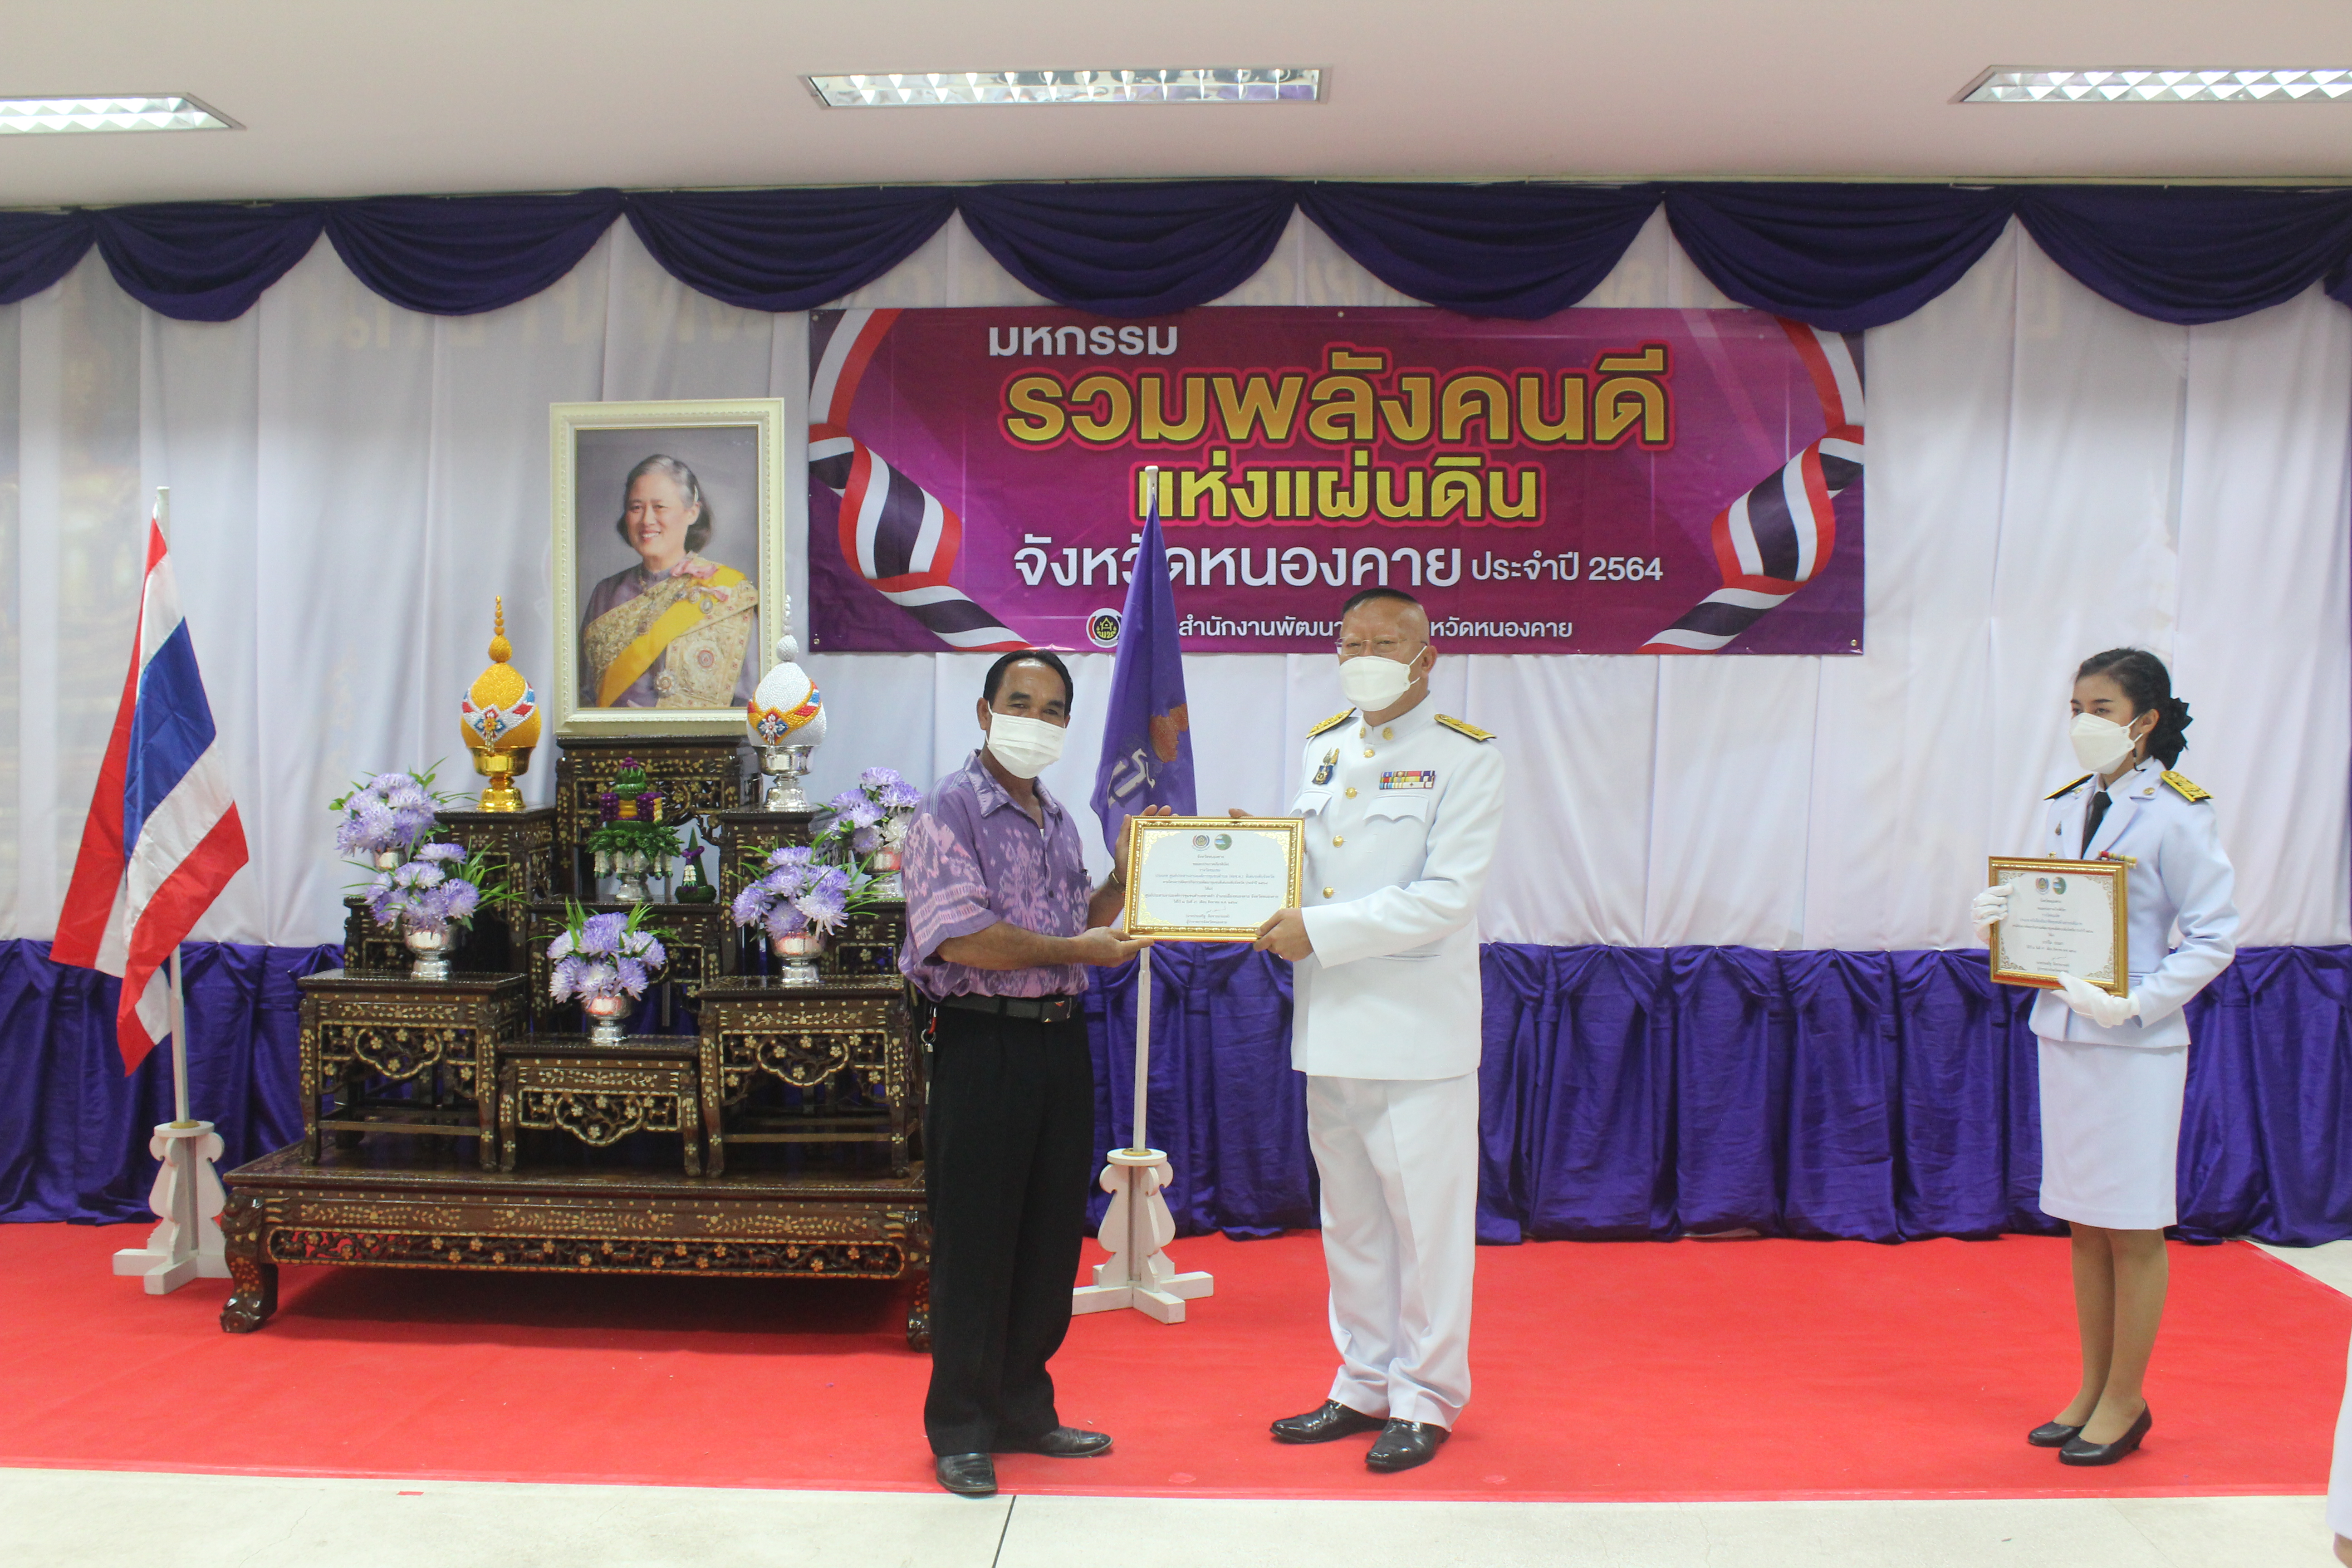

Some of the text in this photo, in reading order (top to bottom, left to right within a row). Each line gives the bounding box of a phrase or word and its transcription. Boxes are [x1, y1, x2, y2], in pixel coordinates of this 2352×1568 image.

[989, 325, 1178, 357] มหกรรม
[1007, 348, 1665, 442] รวมพลังคนดี
[1139, 451, 1536, 519] แห่งแผ่นดิน
[1472, 550, 1580, 581] ประจำปี
[1588, 557, 1664, 582] 2564
